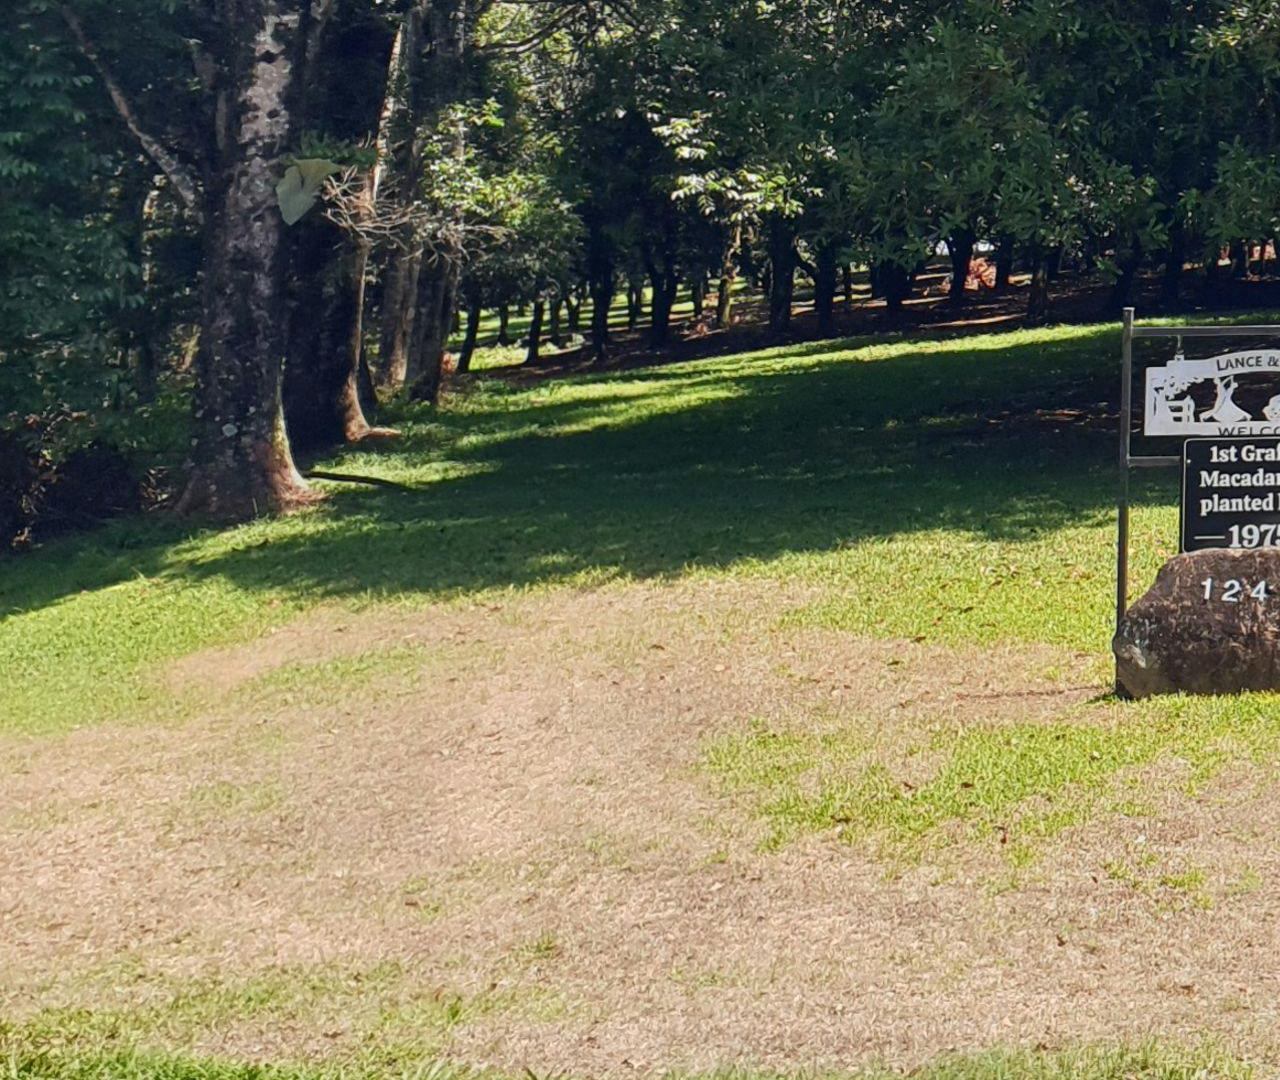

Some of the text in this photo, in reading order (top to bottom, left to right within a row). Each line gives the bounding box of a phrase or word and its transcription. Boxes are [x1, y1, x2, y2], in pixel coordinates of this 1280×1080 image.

[1267, 355, 1280, 368] &
[1209, 445, 1238, 463] 1st
[1200, 493, 1274, 515] planted
